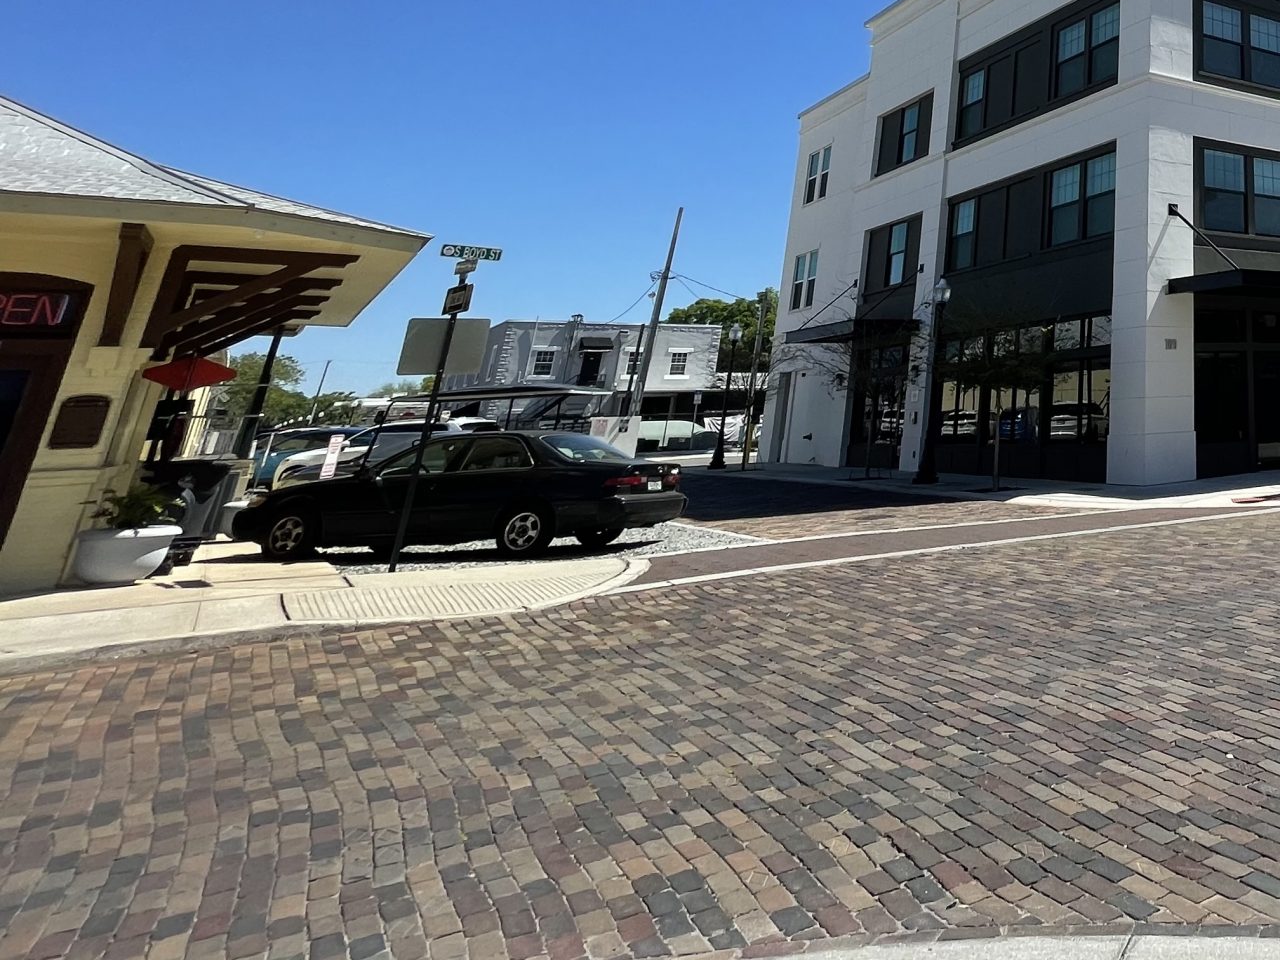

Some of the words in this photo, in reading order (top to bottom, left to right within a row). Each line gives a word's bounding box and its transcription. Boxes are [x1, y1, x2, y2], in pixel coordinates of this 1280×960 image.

[453, 246, 461, 257] S
[463, 247, 487, 259] BOYD
[488, 249, 501, 260] ST
